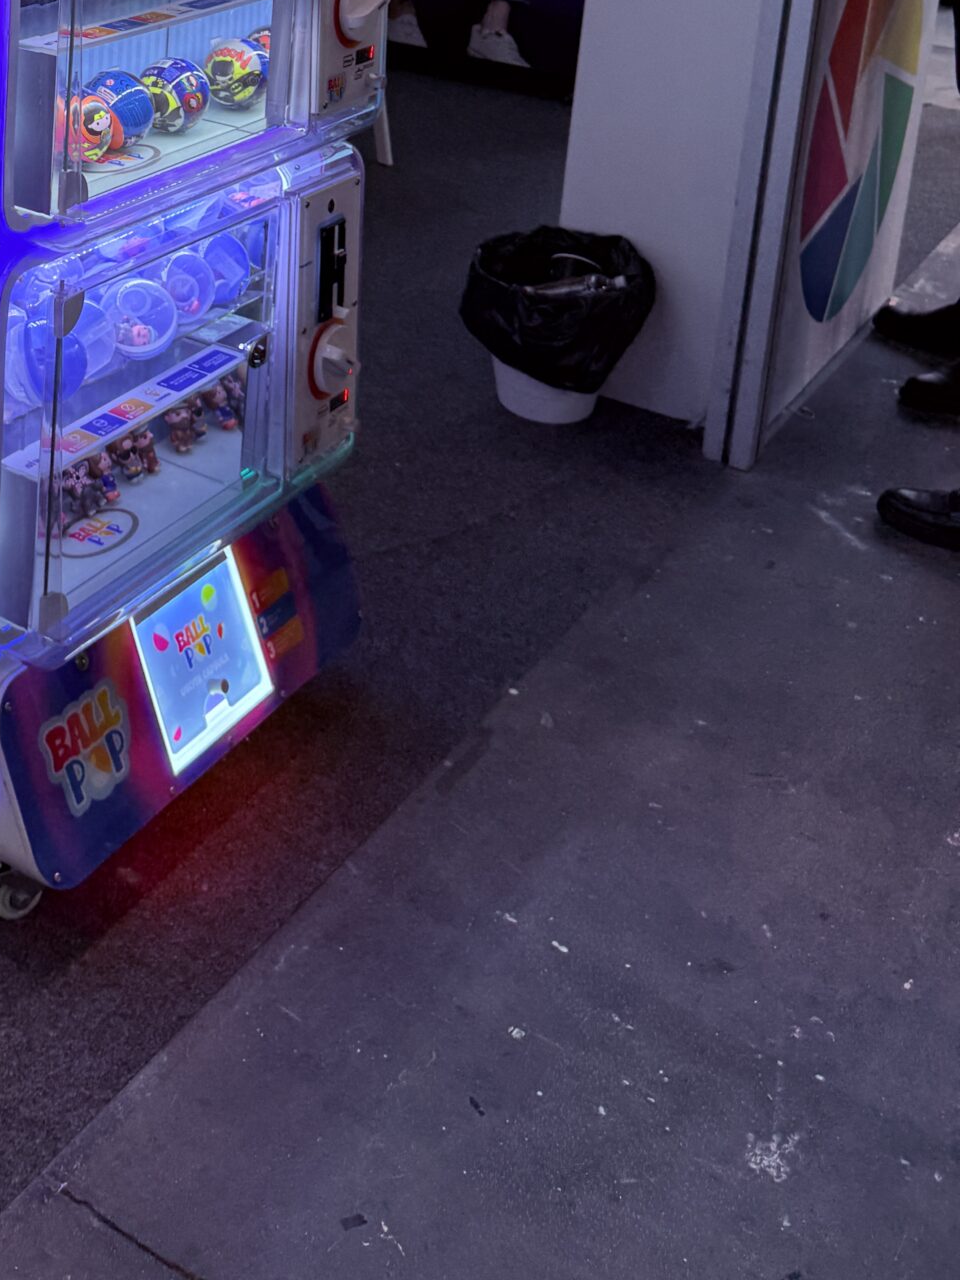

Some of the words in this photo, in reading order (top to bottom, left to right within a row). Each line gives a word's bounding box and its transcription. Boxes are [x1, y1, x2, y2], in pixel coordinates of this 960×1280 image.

[174, 614, 211, 653] BALL
[45, 687, 122, 773] BALL
[65, 729, 124, 805] POP
